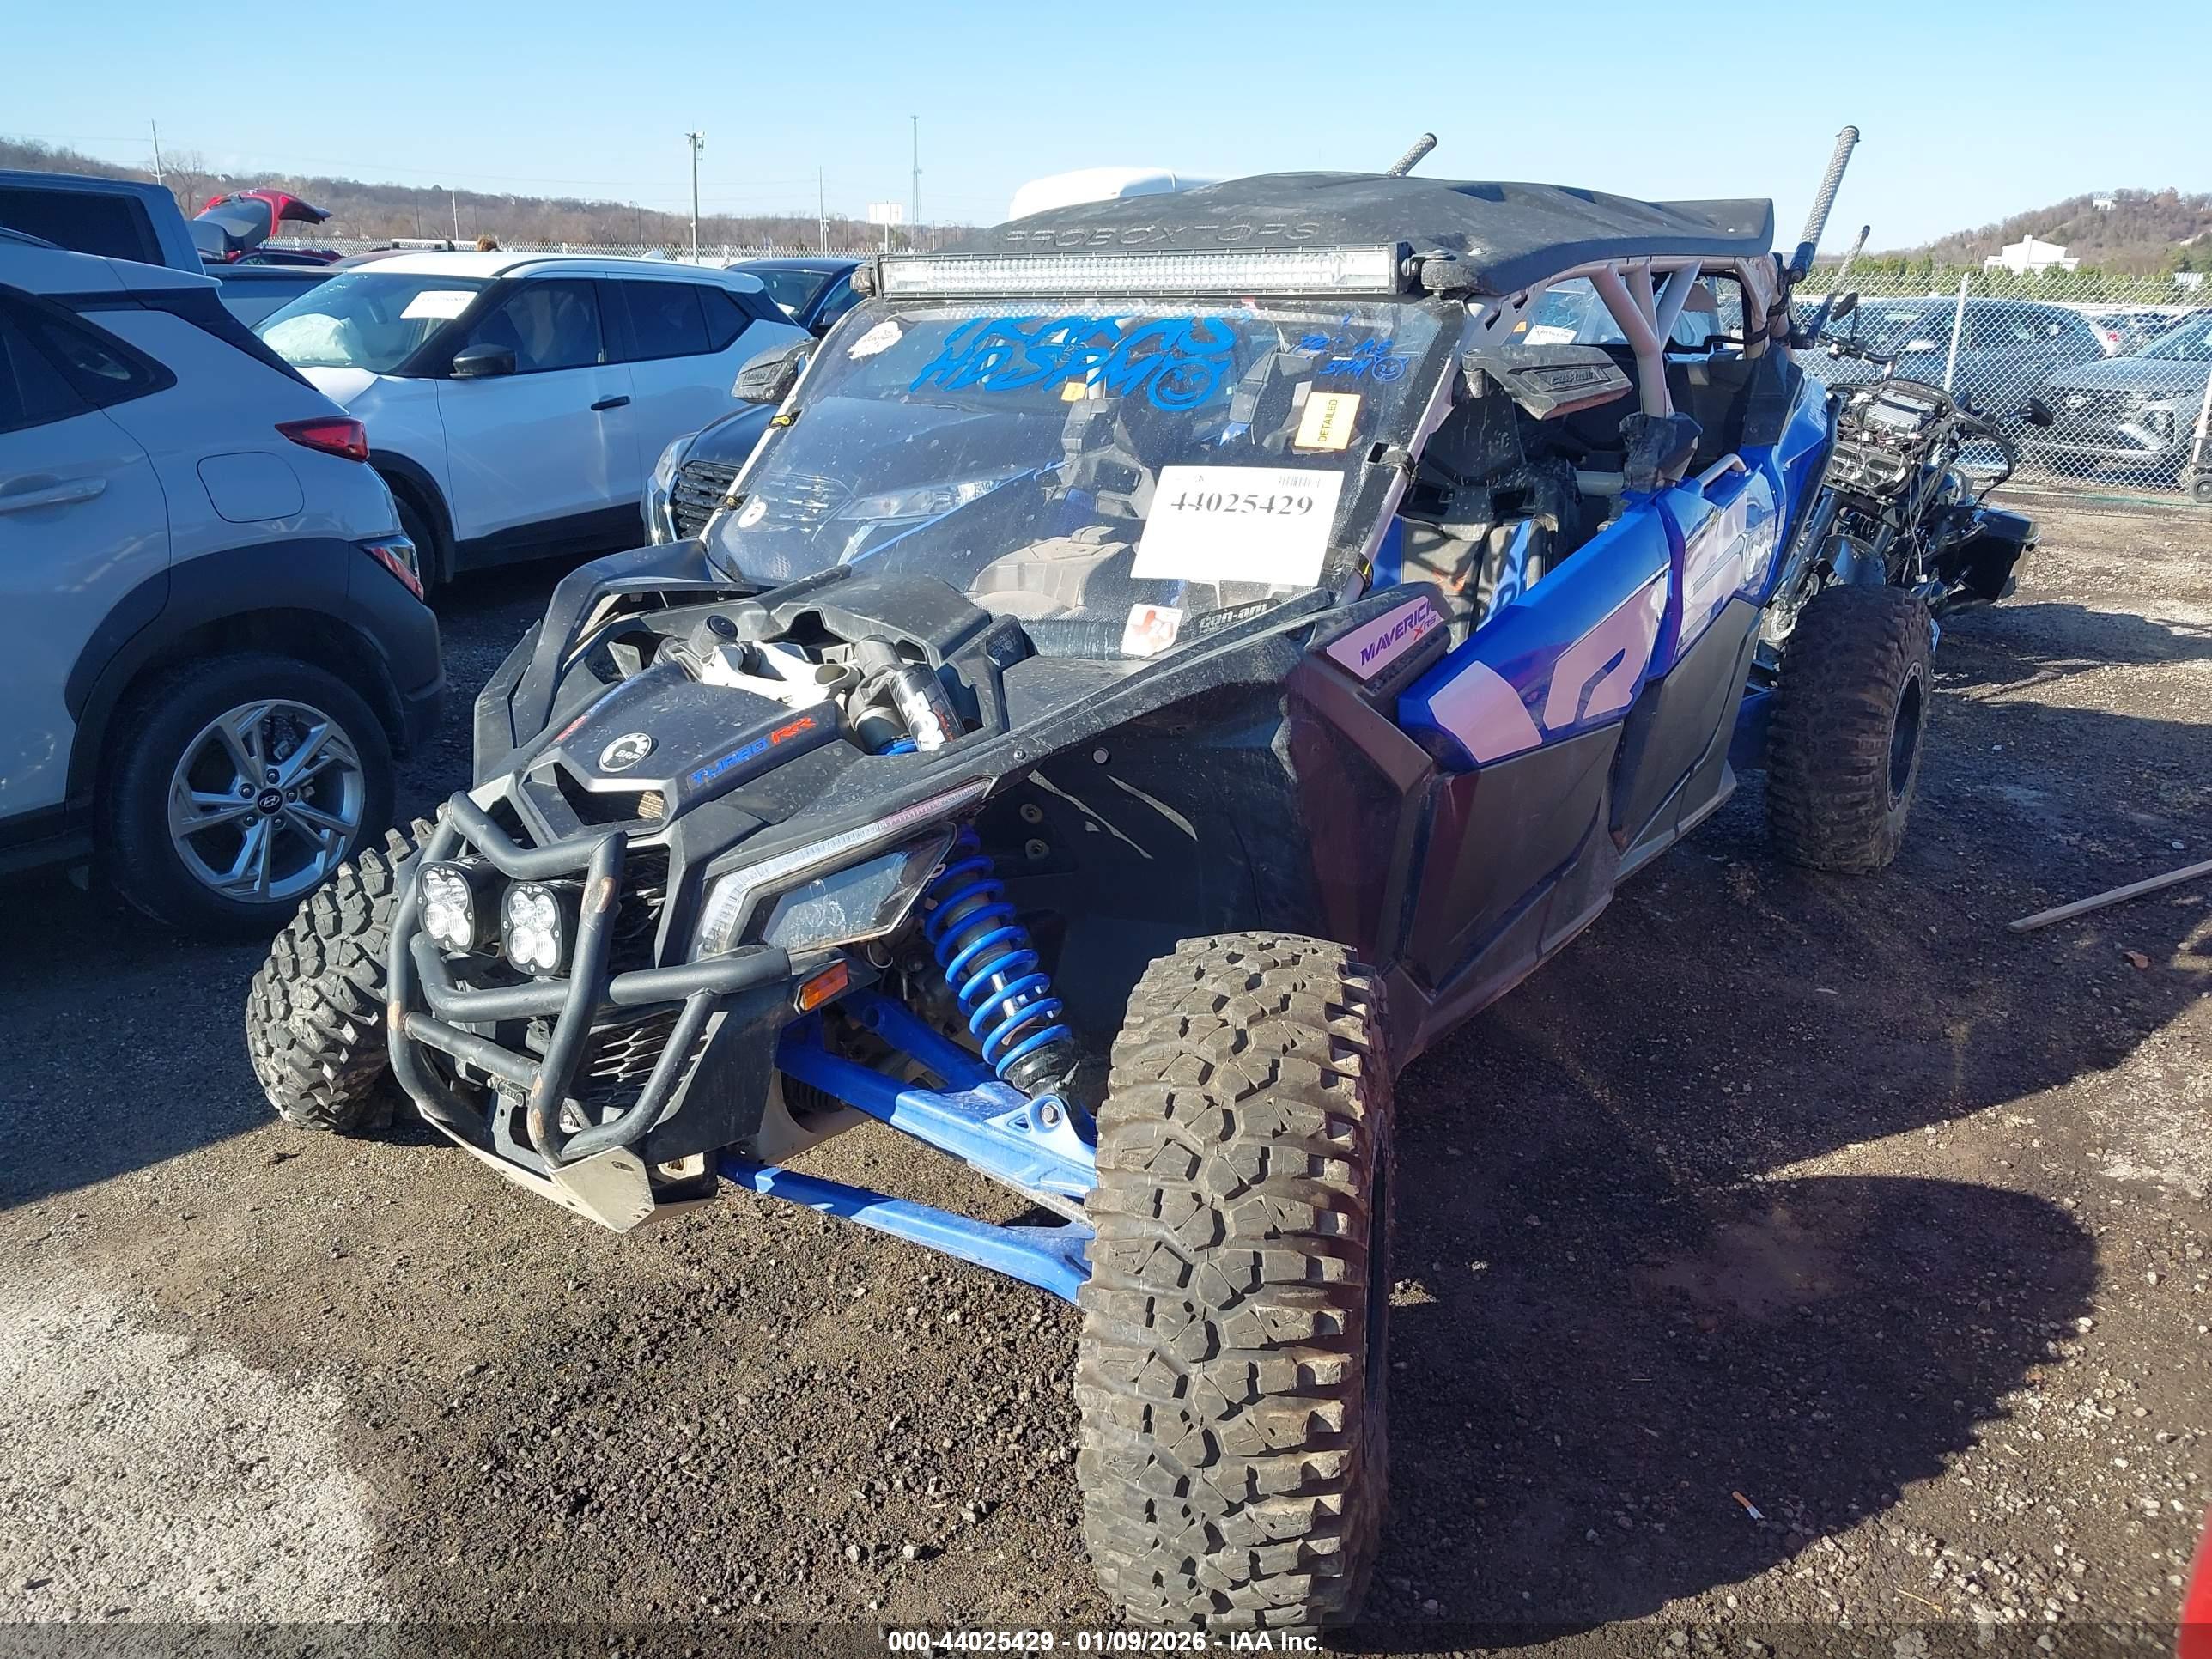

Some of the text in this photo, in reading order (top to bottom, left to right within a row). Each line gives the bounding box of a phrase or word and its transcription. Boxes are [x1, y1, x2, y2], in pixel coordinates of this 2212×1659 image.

[1317, 398, 1338, 442] DETAILED
[1170, 491, 1314, 516] 44025429
[614, 749, 641, 760] BRP
[690, 716, 817, 785] TURBO RR
